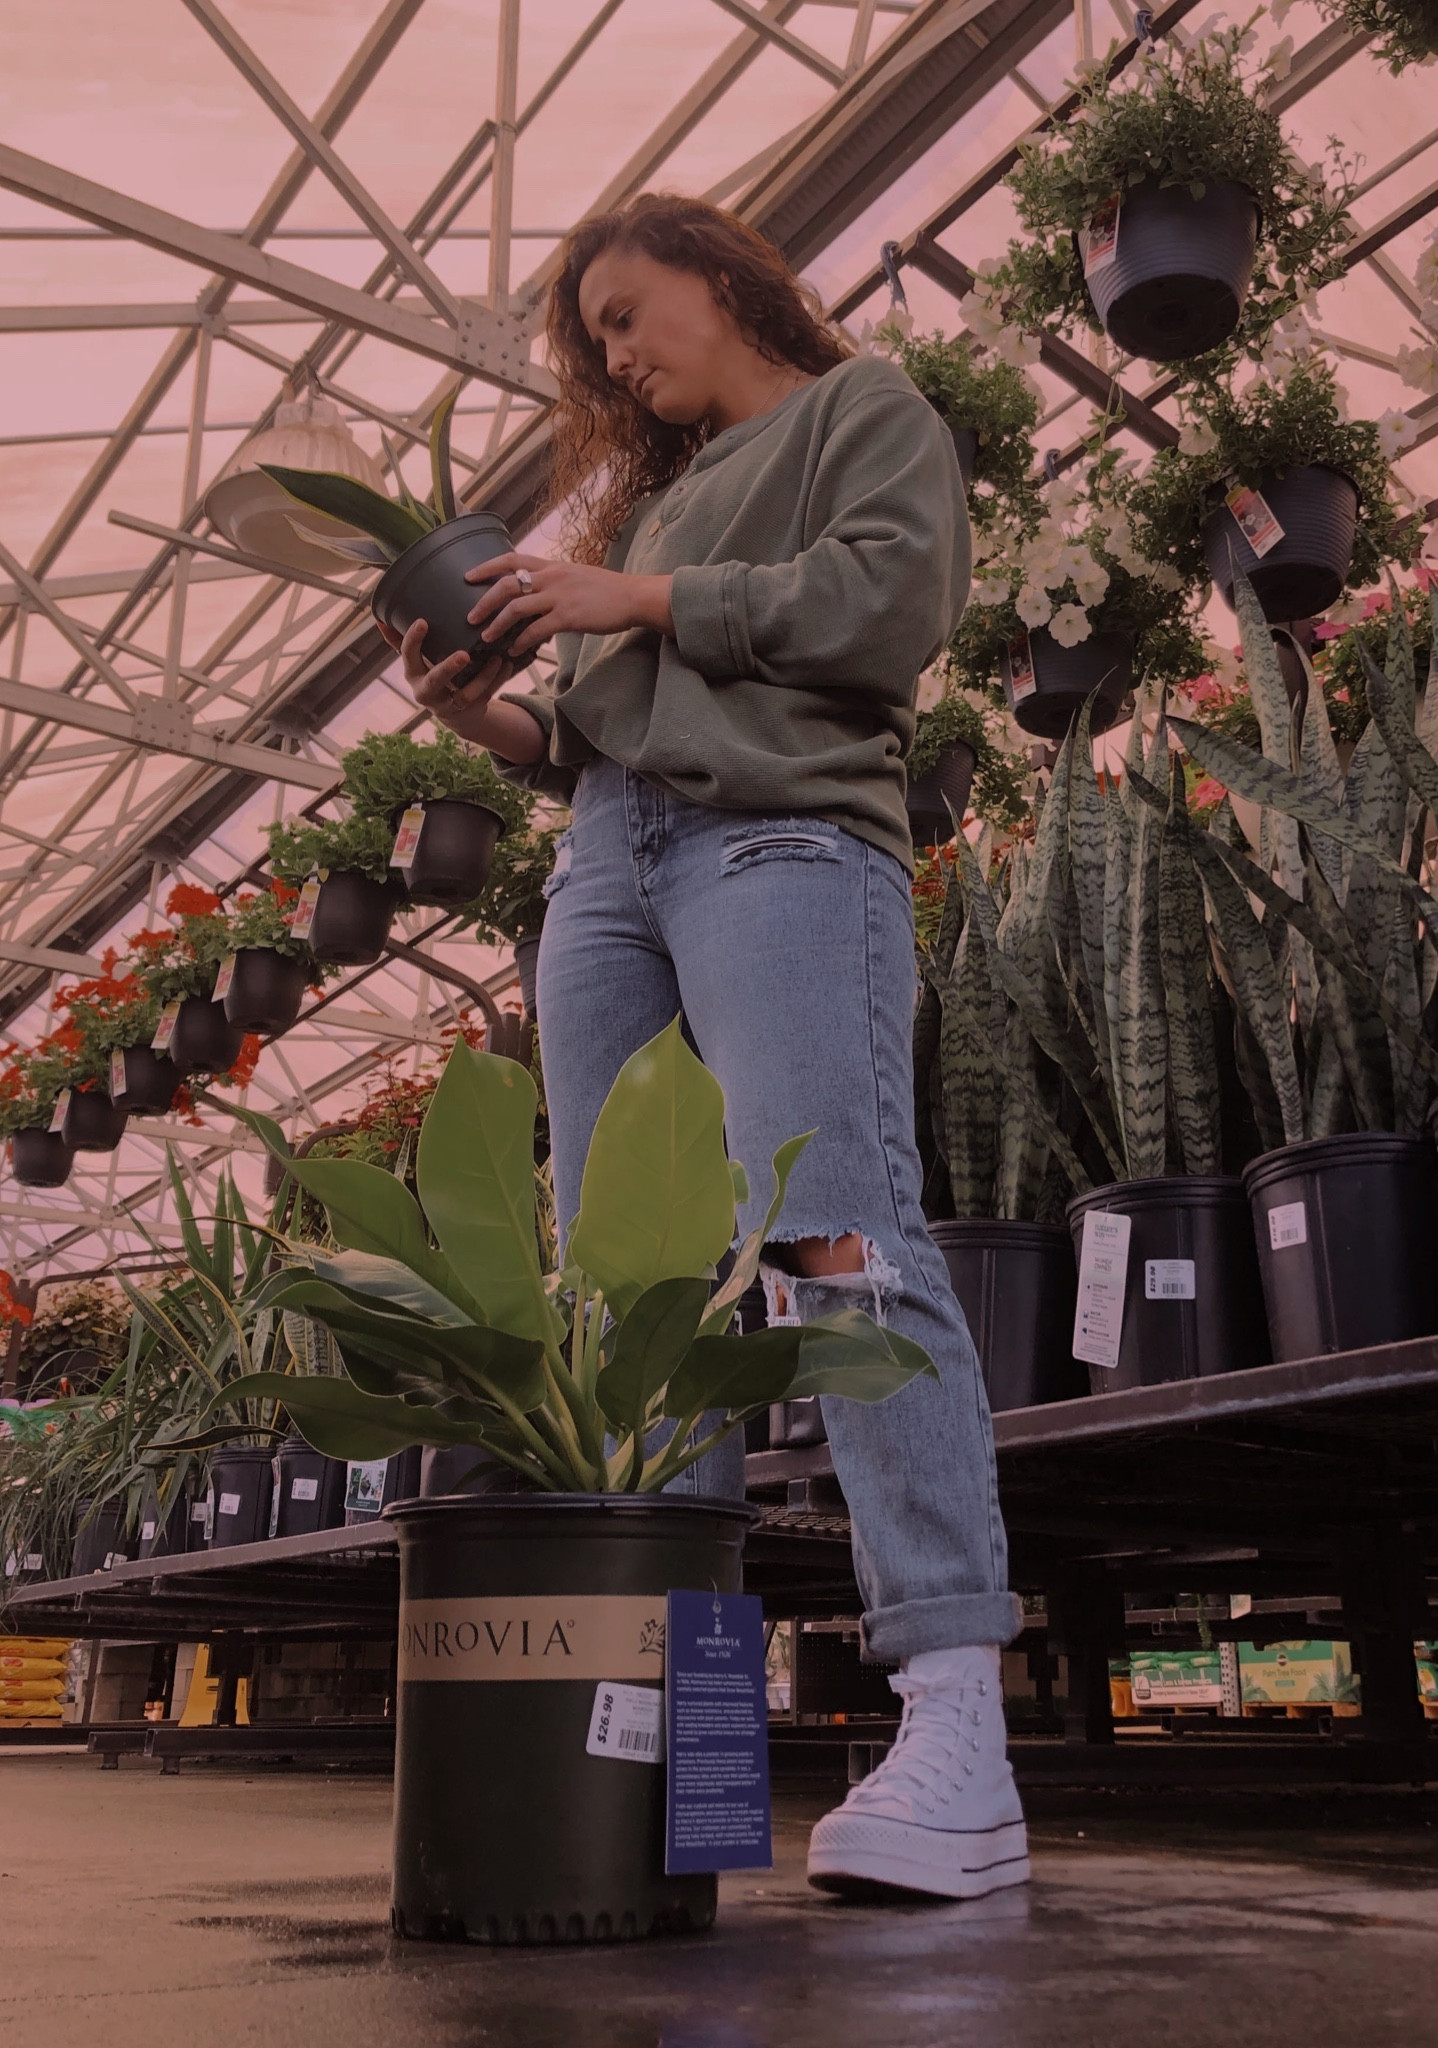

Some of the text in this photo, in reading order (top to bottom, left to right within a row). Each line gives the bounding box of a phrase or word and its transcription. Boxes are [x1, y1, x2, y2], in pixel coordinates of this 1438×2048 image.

[402, 1620, 574, 1658] ONROVIA
[696, 1636, 741, 1648] MONROVIA
[597, 1694, 614, 1744] $26.98
